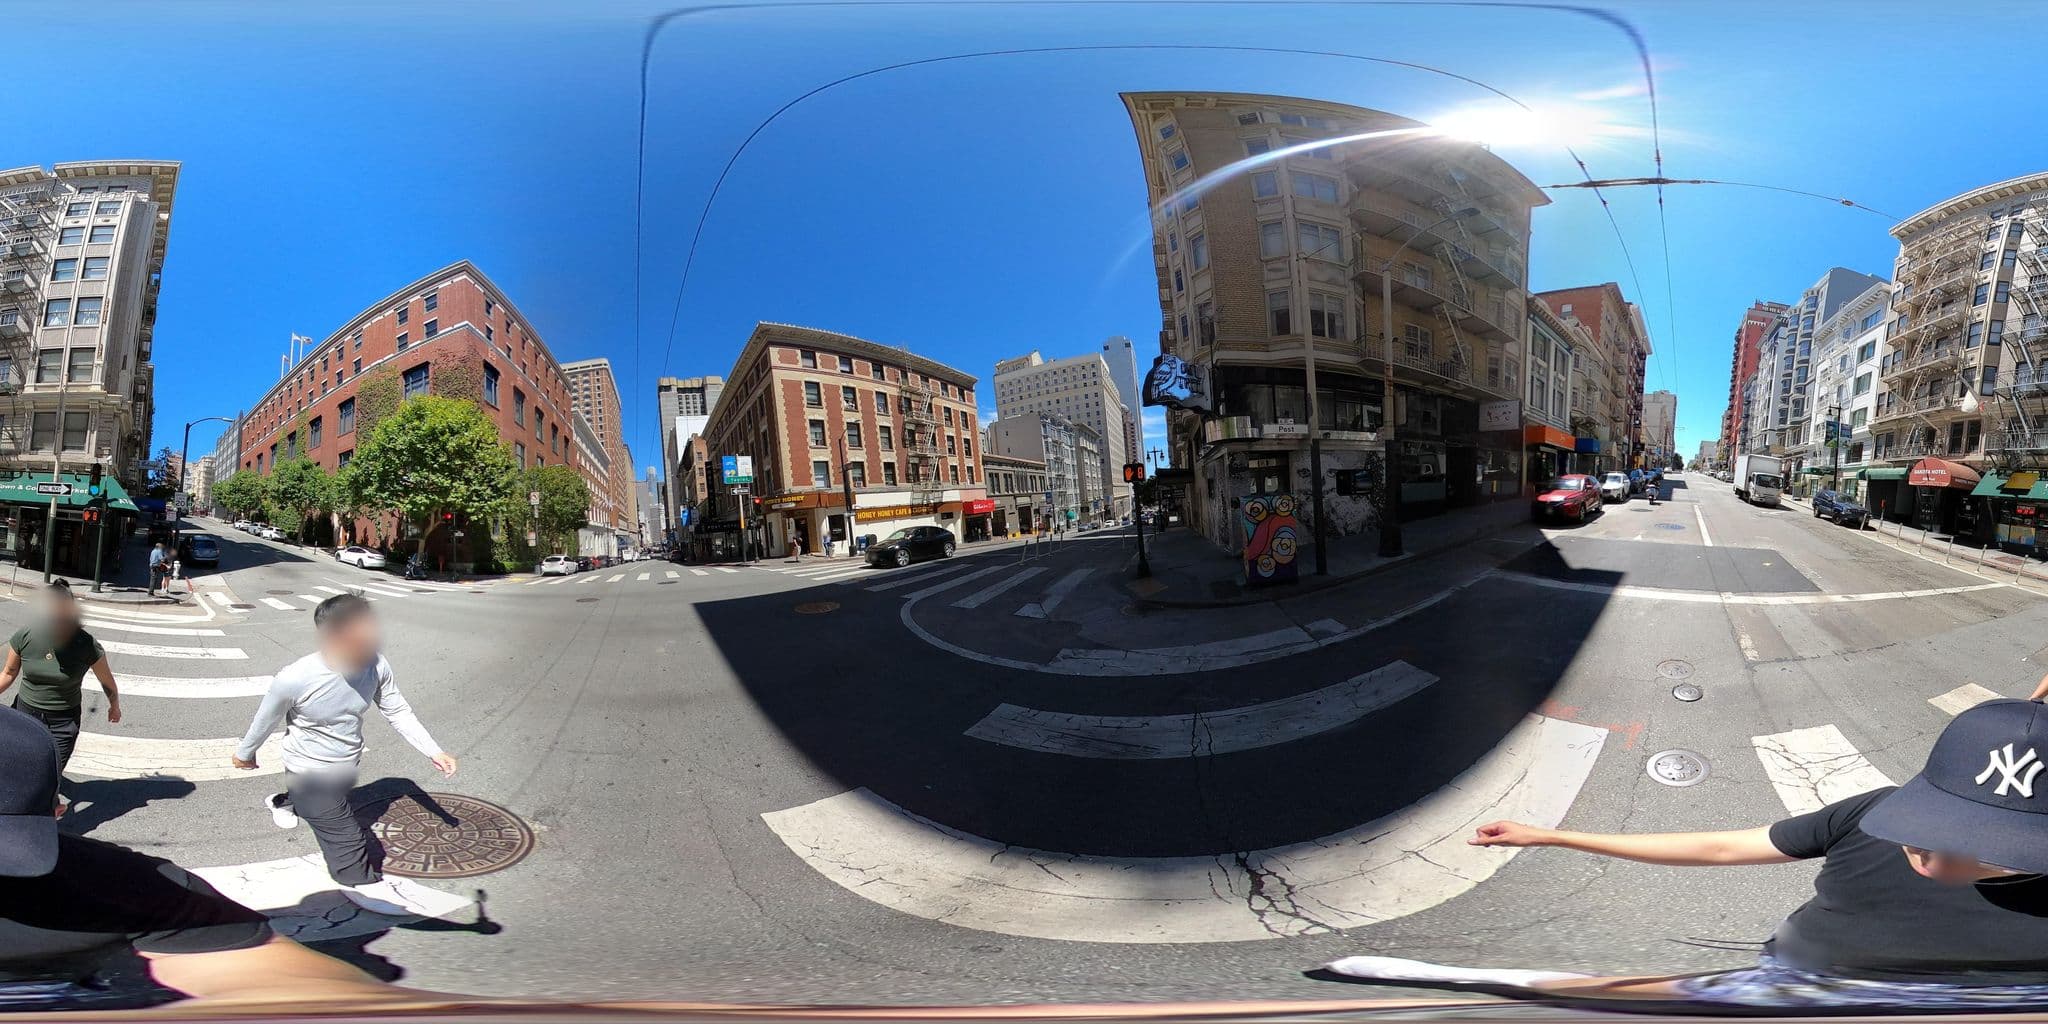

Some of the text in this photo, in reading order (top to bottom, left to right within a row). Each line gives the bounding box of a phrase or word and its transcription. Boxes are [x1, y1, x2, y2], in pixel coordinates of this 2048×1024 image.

[1137, 466, 1143, 479] 8
[857, 510, 877, 519] HONEY
[877, 509, 895, 517] HONEY
[1975, 743, 2045, 798] NY
